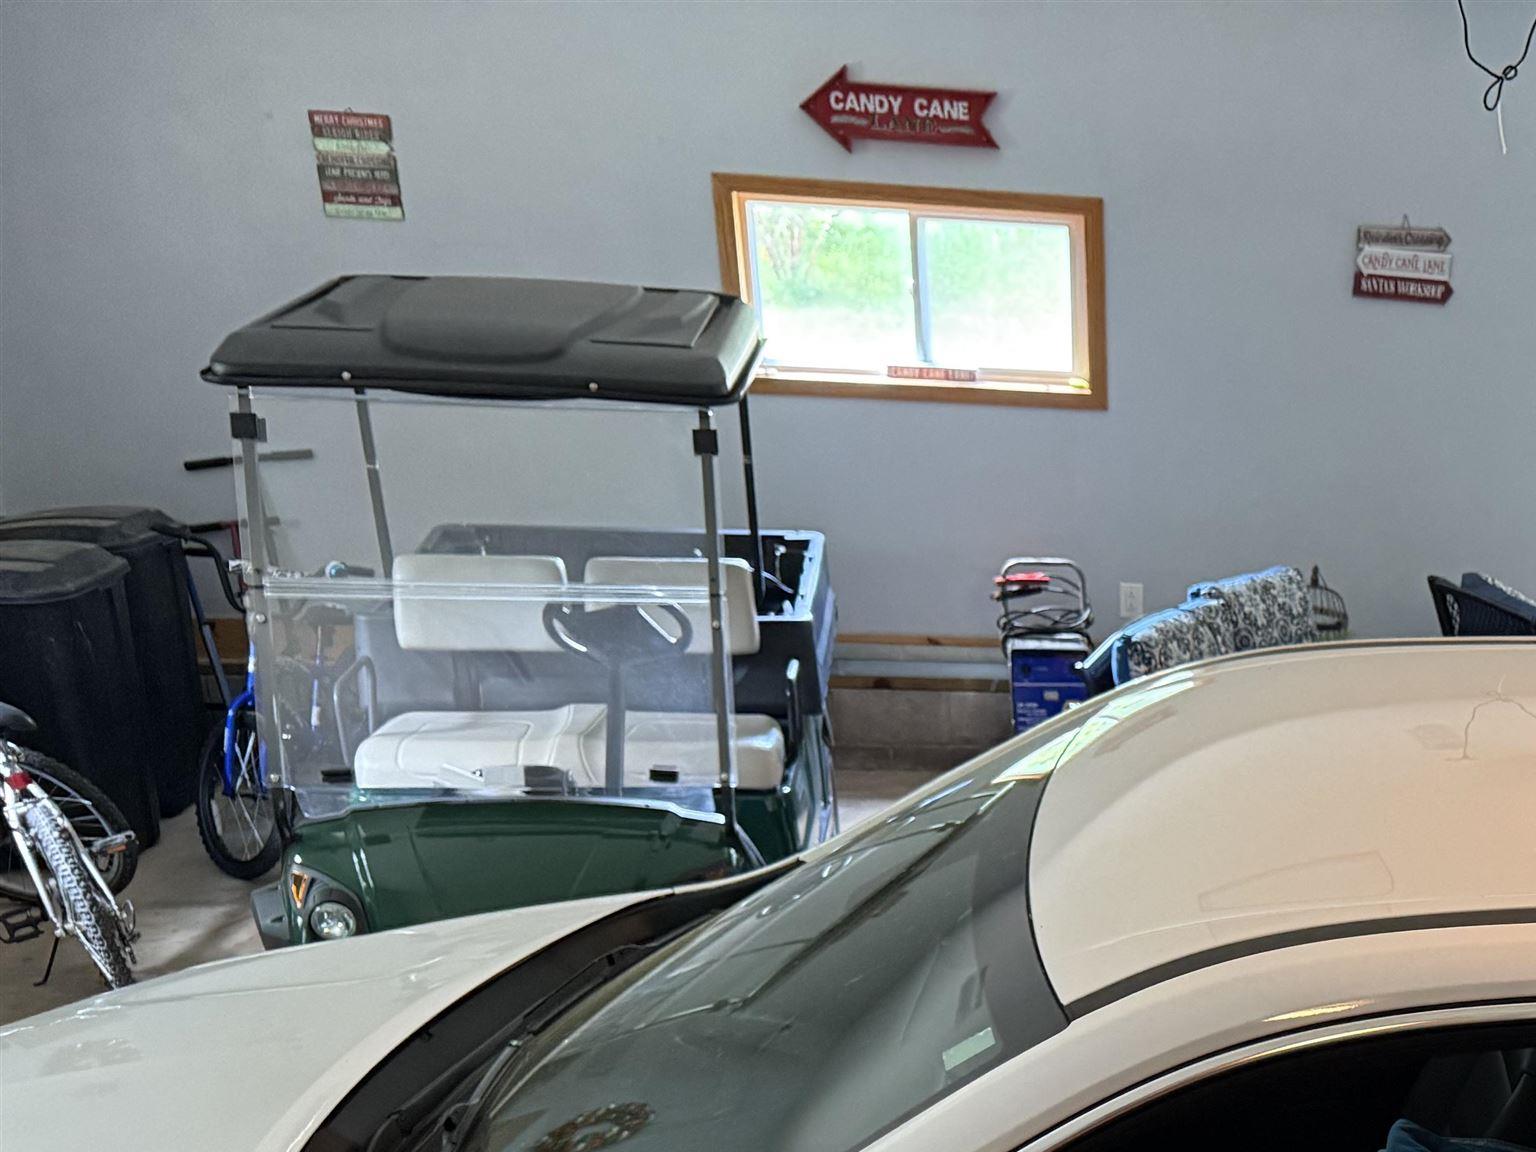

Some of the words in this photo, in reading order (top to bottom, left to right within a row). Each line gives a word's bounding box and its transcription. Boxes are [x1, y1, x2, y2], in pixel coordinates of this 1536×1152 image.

[829, 90, 902, 115] CANDY
[914, 98, 969, 120] CANE
[1361, 252, 1393, 270] CANDY
[1395, 254, 1419, 271] CANE
[1423, 258, 1446, 275] LANE
